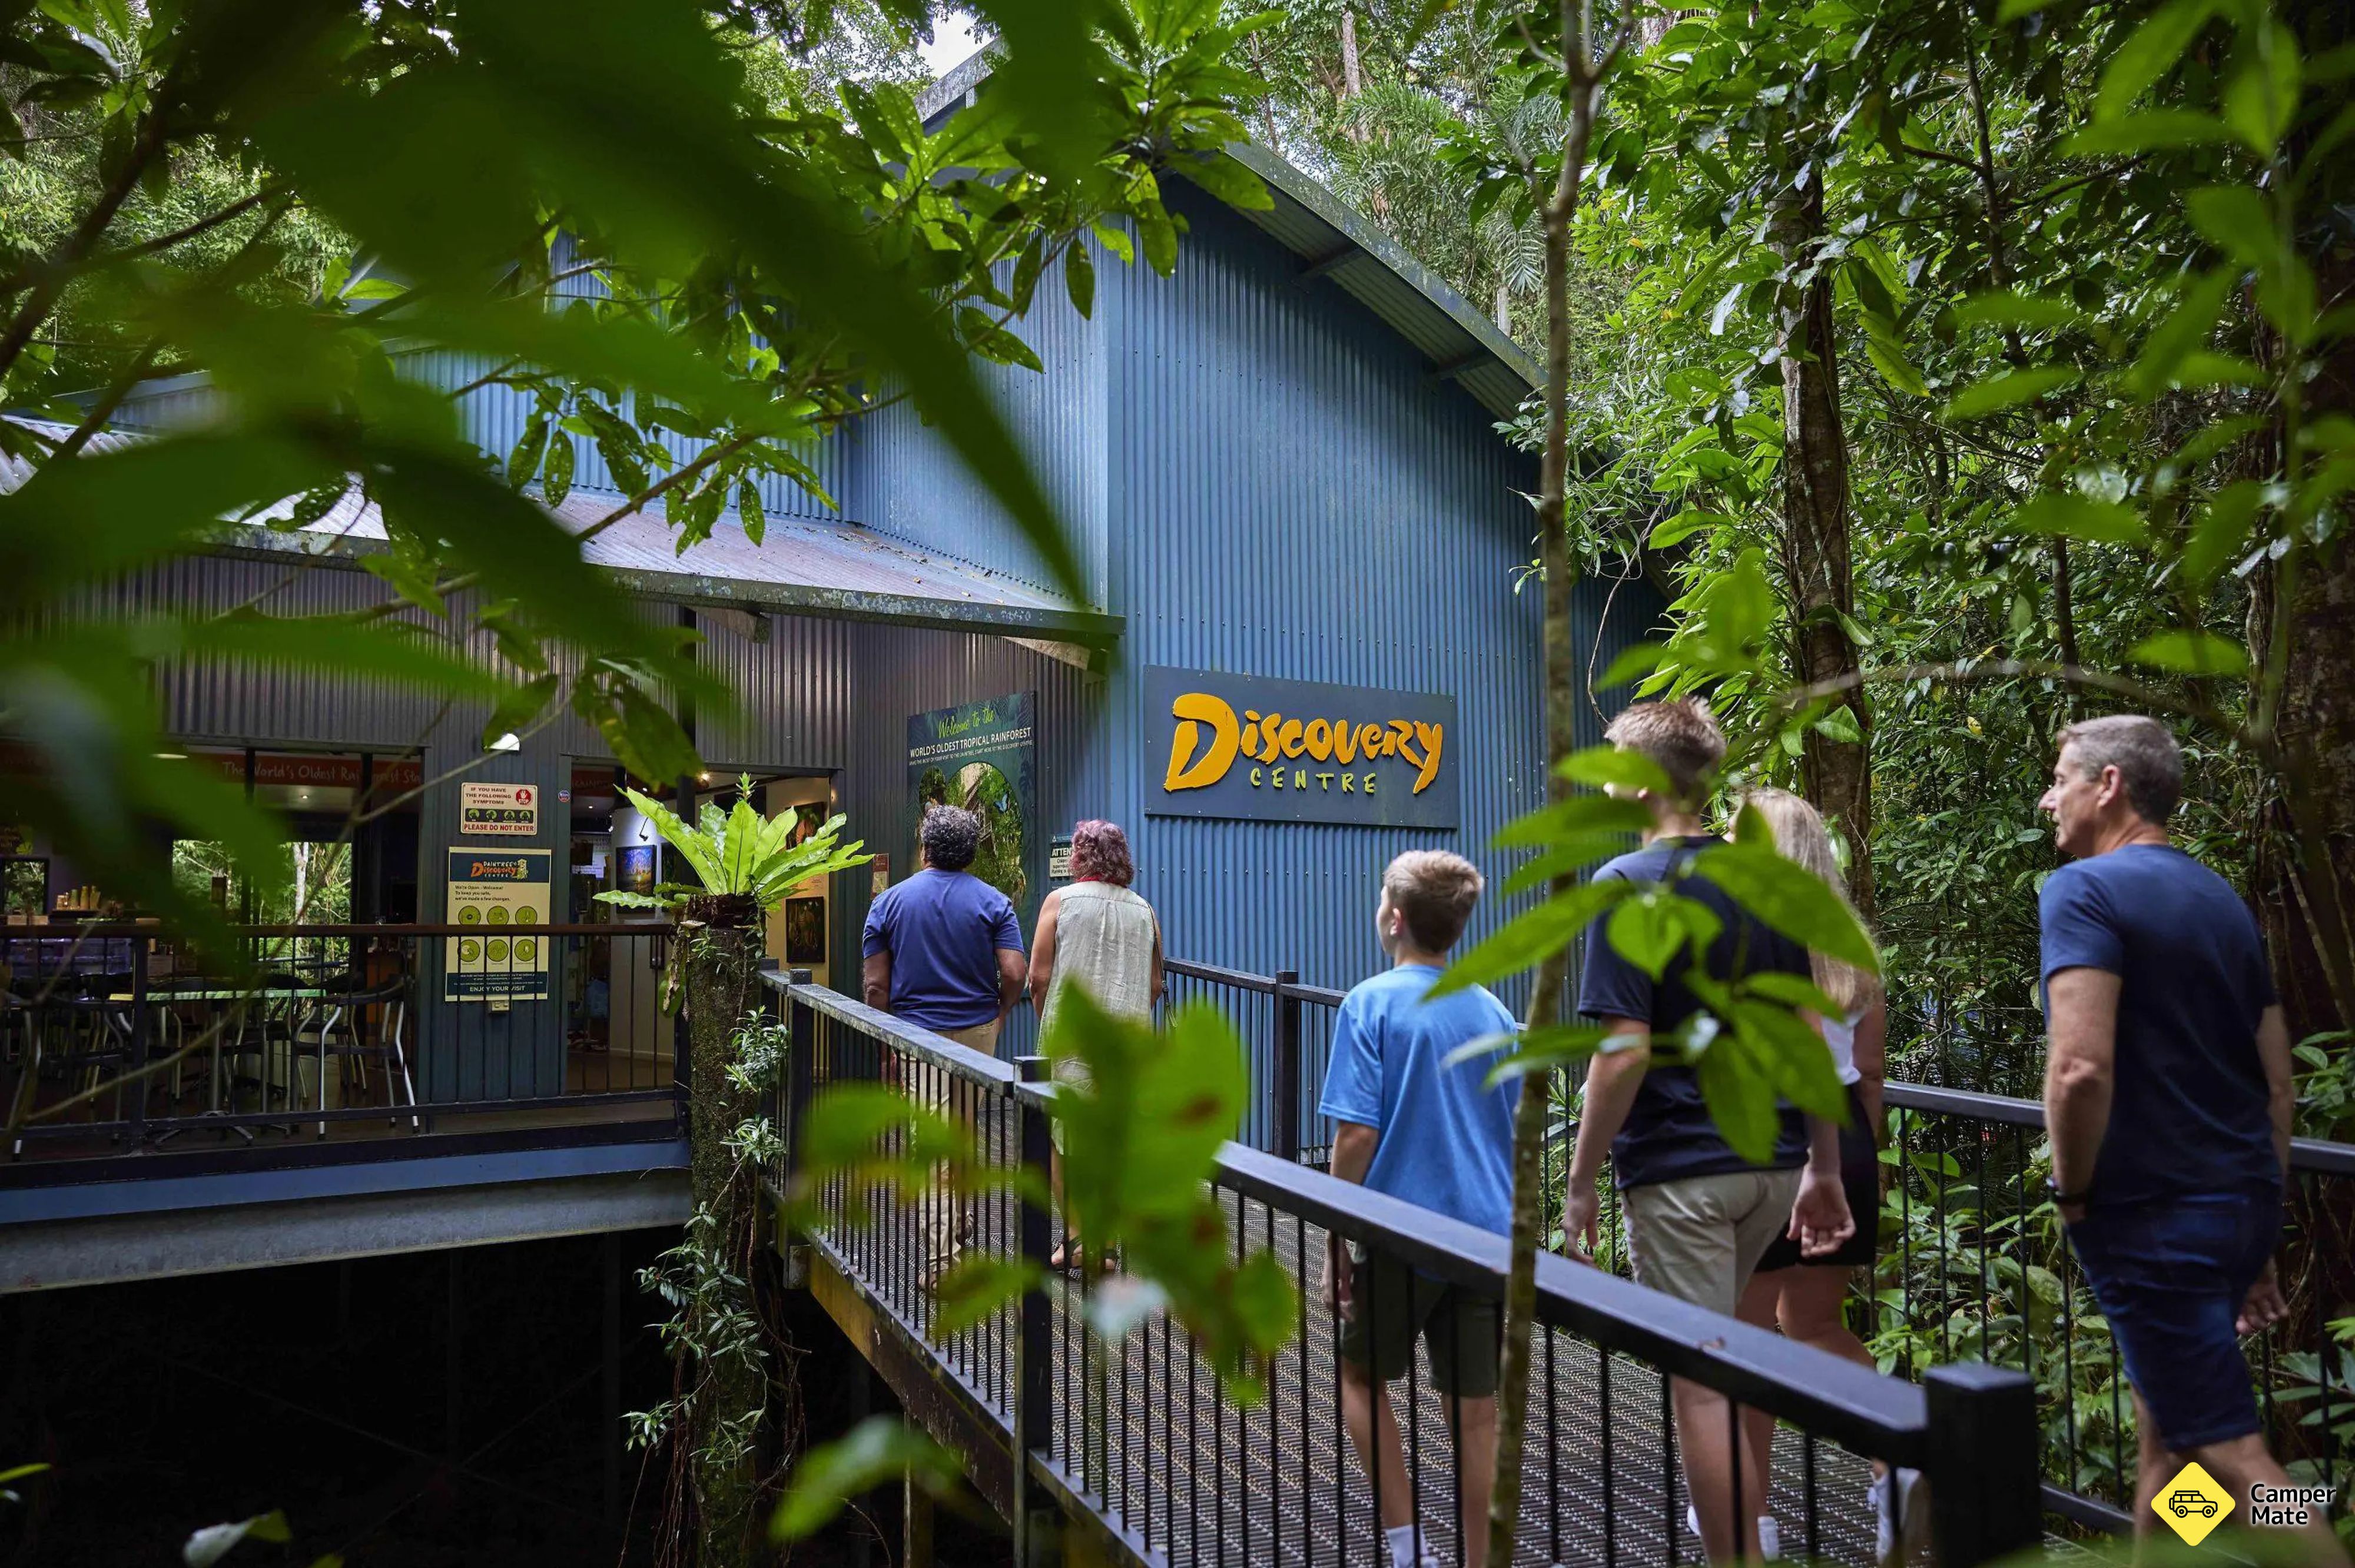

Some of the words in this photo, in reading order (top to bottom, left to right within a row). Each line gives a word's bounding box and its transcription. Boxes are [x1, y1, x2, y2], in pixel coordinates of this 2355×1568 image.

[938, 716, 969, 739] Welcome
[973, 712, 980, 727] to
[910, 744, 936, 758] WORLD'S
[937, 740, 959, 753] OLDEST
[960, 736, 990, 750] TROPICAL
[991, 727, 1031, 743] RAINFOREST
[298, 765, 334, 780] Oldest
[1251, 767, 1376, 794] CENTRE
[1052, 848, 1072, 856] ATTEN
